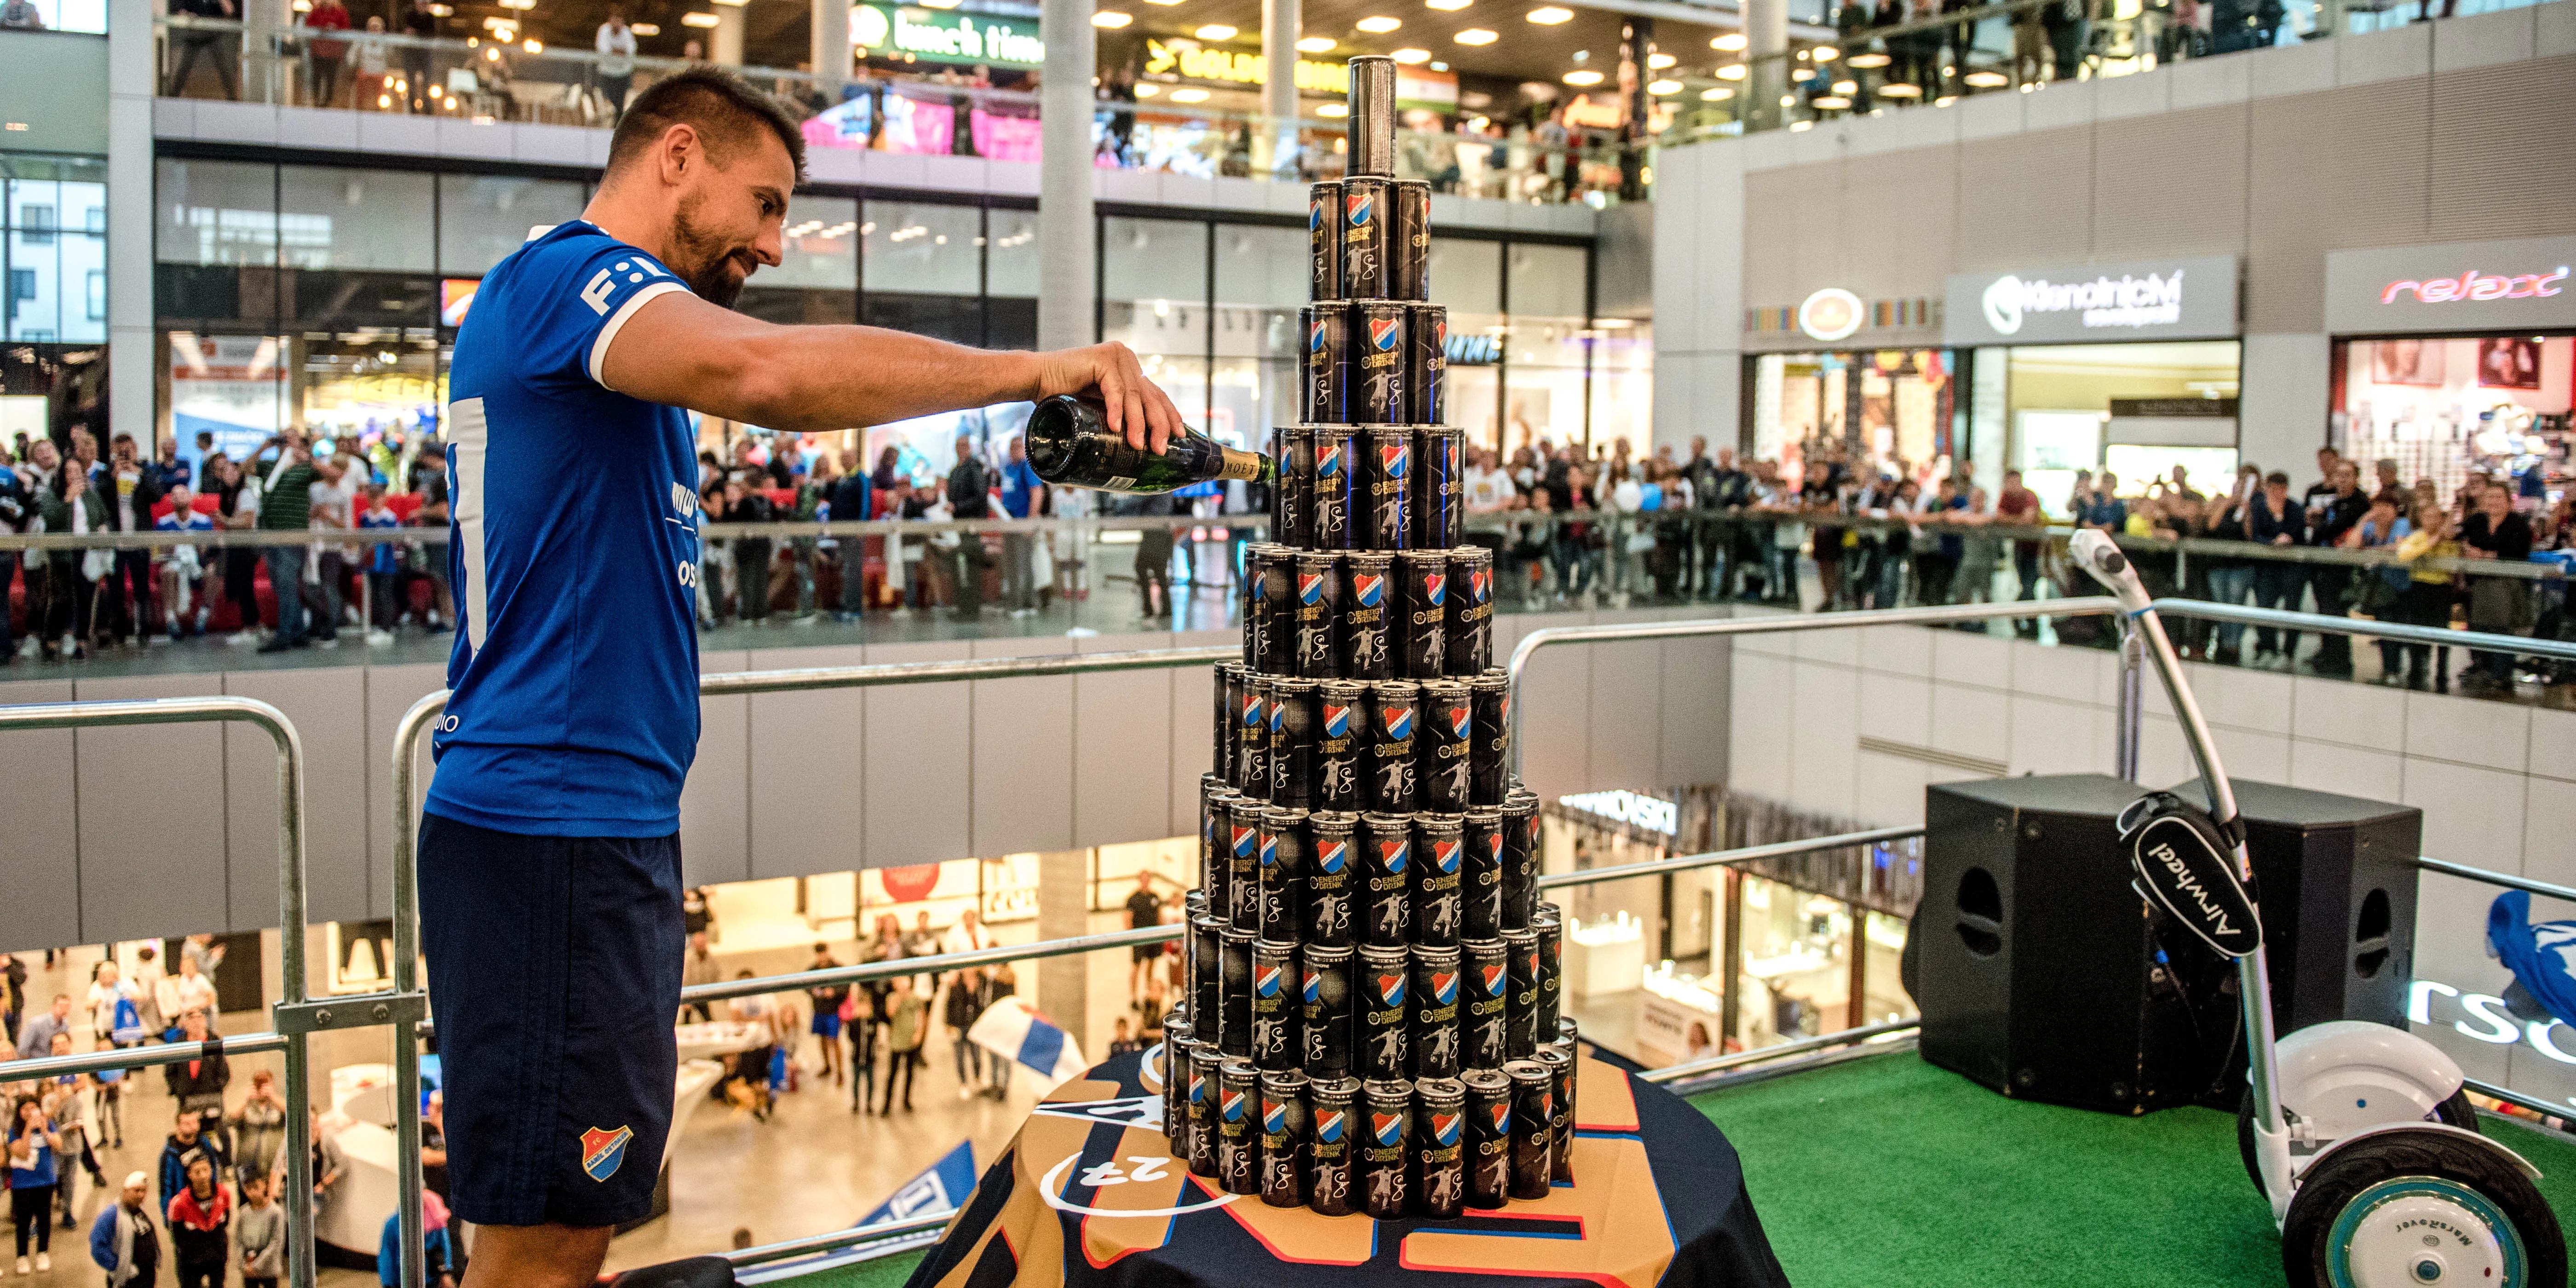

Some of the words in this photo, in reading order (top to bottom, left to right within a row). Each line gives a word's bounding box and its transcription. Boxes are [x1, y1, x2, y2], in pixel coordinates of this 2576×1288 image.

[1180, 46, 1268, 85] GOLDE
[1371, 351, 1398, 361] ENERGY
[1372, 358, 1395, 368] DRINK
[1383, 484, 1406, 494] DRINK
[672, 481, 699, 518] MW
[1356, 606, 1383, 616] ENERGY
[1357, 615, 1380, 624] DRINK
[1324, 738, 1351, 748] ENERGY
[1385, 740, 1413, 749] ENERGY
[1386, 748, 1409, 756] DRINK
[1318, 874, 1347, 883] ENERGY
[1319, 881, 1343, 890] DRINK
[1383, 881, 1405, 890] DRINK
[1437, 880, 1458, 890] DRINK
[2147, 842, 2241, 935] Airwheel
[1381, 1014, 1402, 1024] DRINK
[1434, 1012, 1455, 1022] DRINK
[1374, 1145, 1403, 1155] ENERGY
[1434, 1144, 1461, 1157] ENERGY
[1435, 1154, 1458, 1163] DRINK
